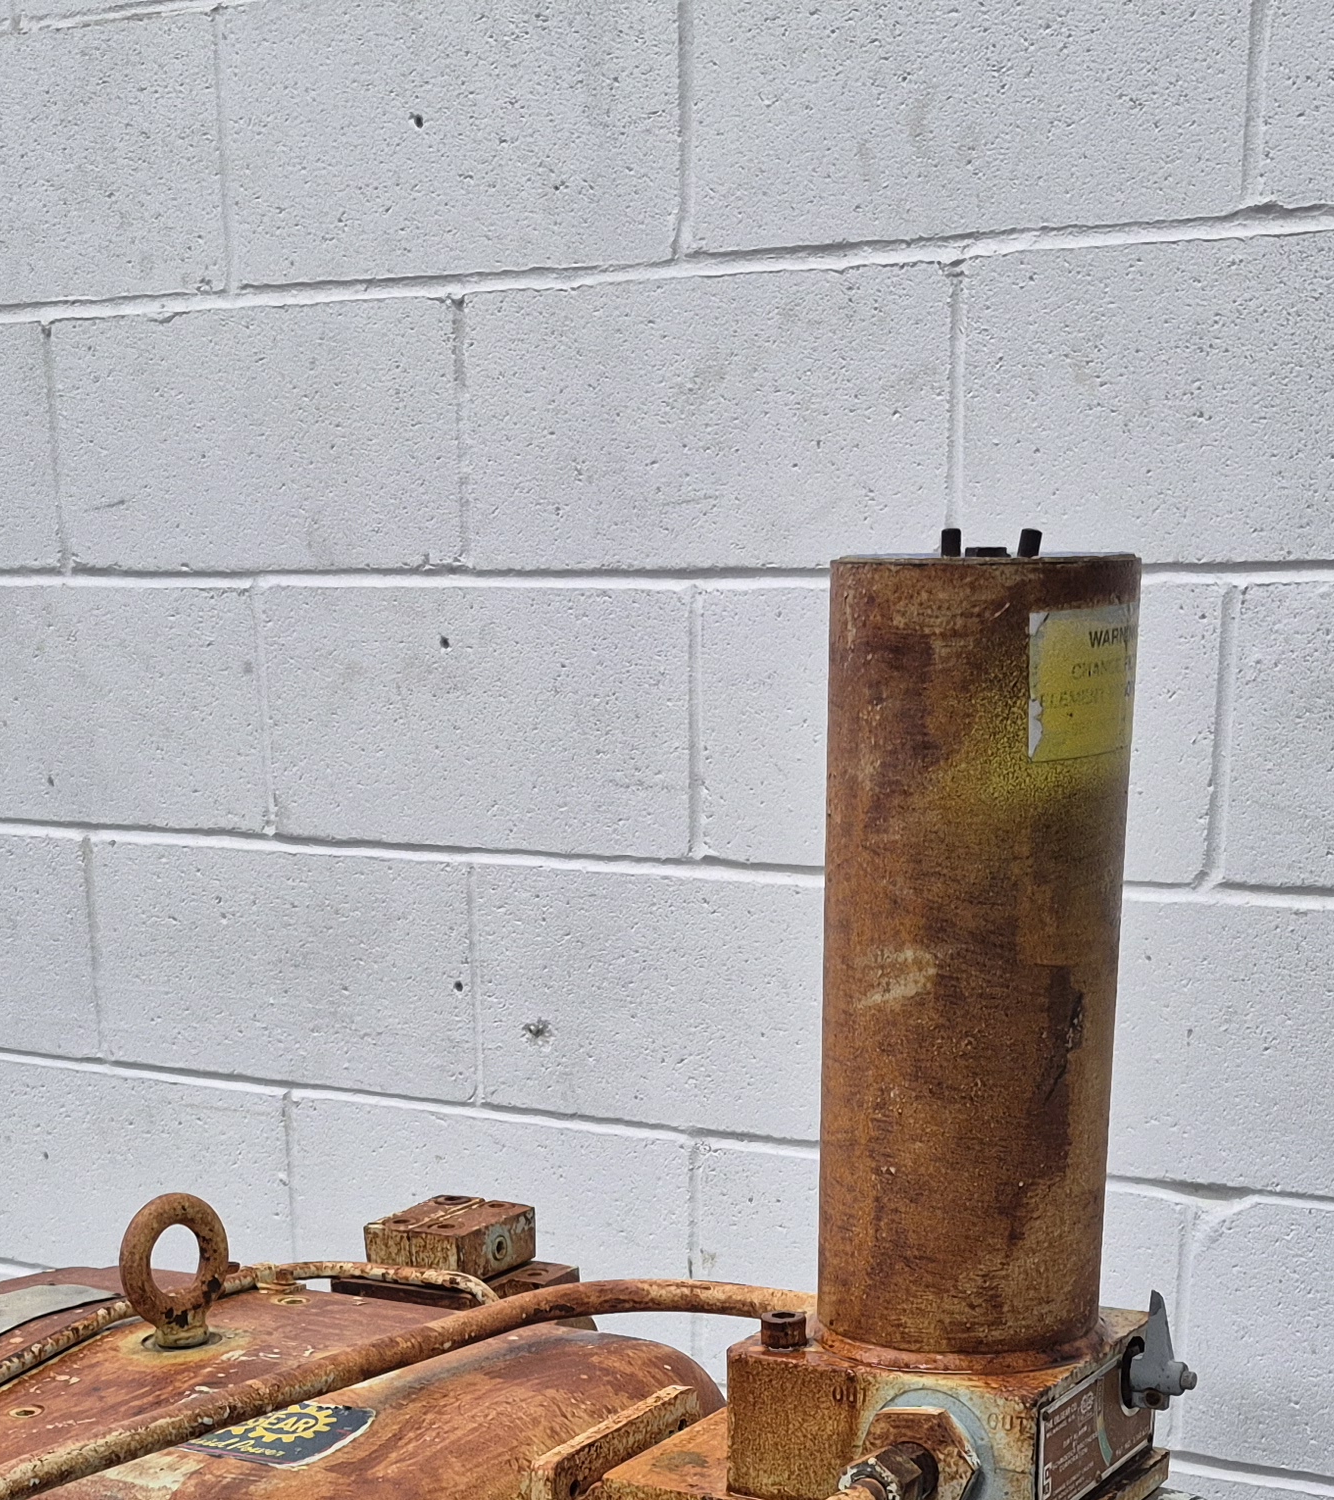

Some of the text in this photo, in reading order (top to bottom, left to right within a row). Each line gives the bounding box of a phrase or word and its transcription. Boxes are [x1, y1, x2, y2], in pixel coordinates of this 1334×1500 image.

[1089, 622, 1137, 648] WARN
[988, 1412, 1034, 1435] OUT
[226, 1438, 286, 1457] Power
